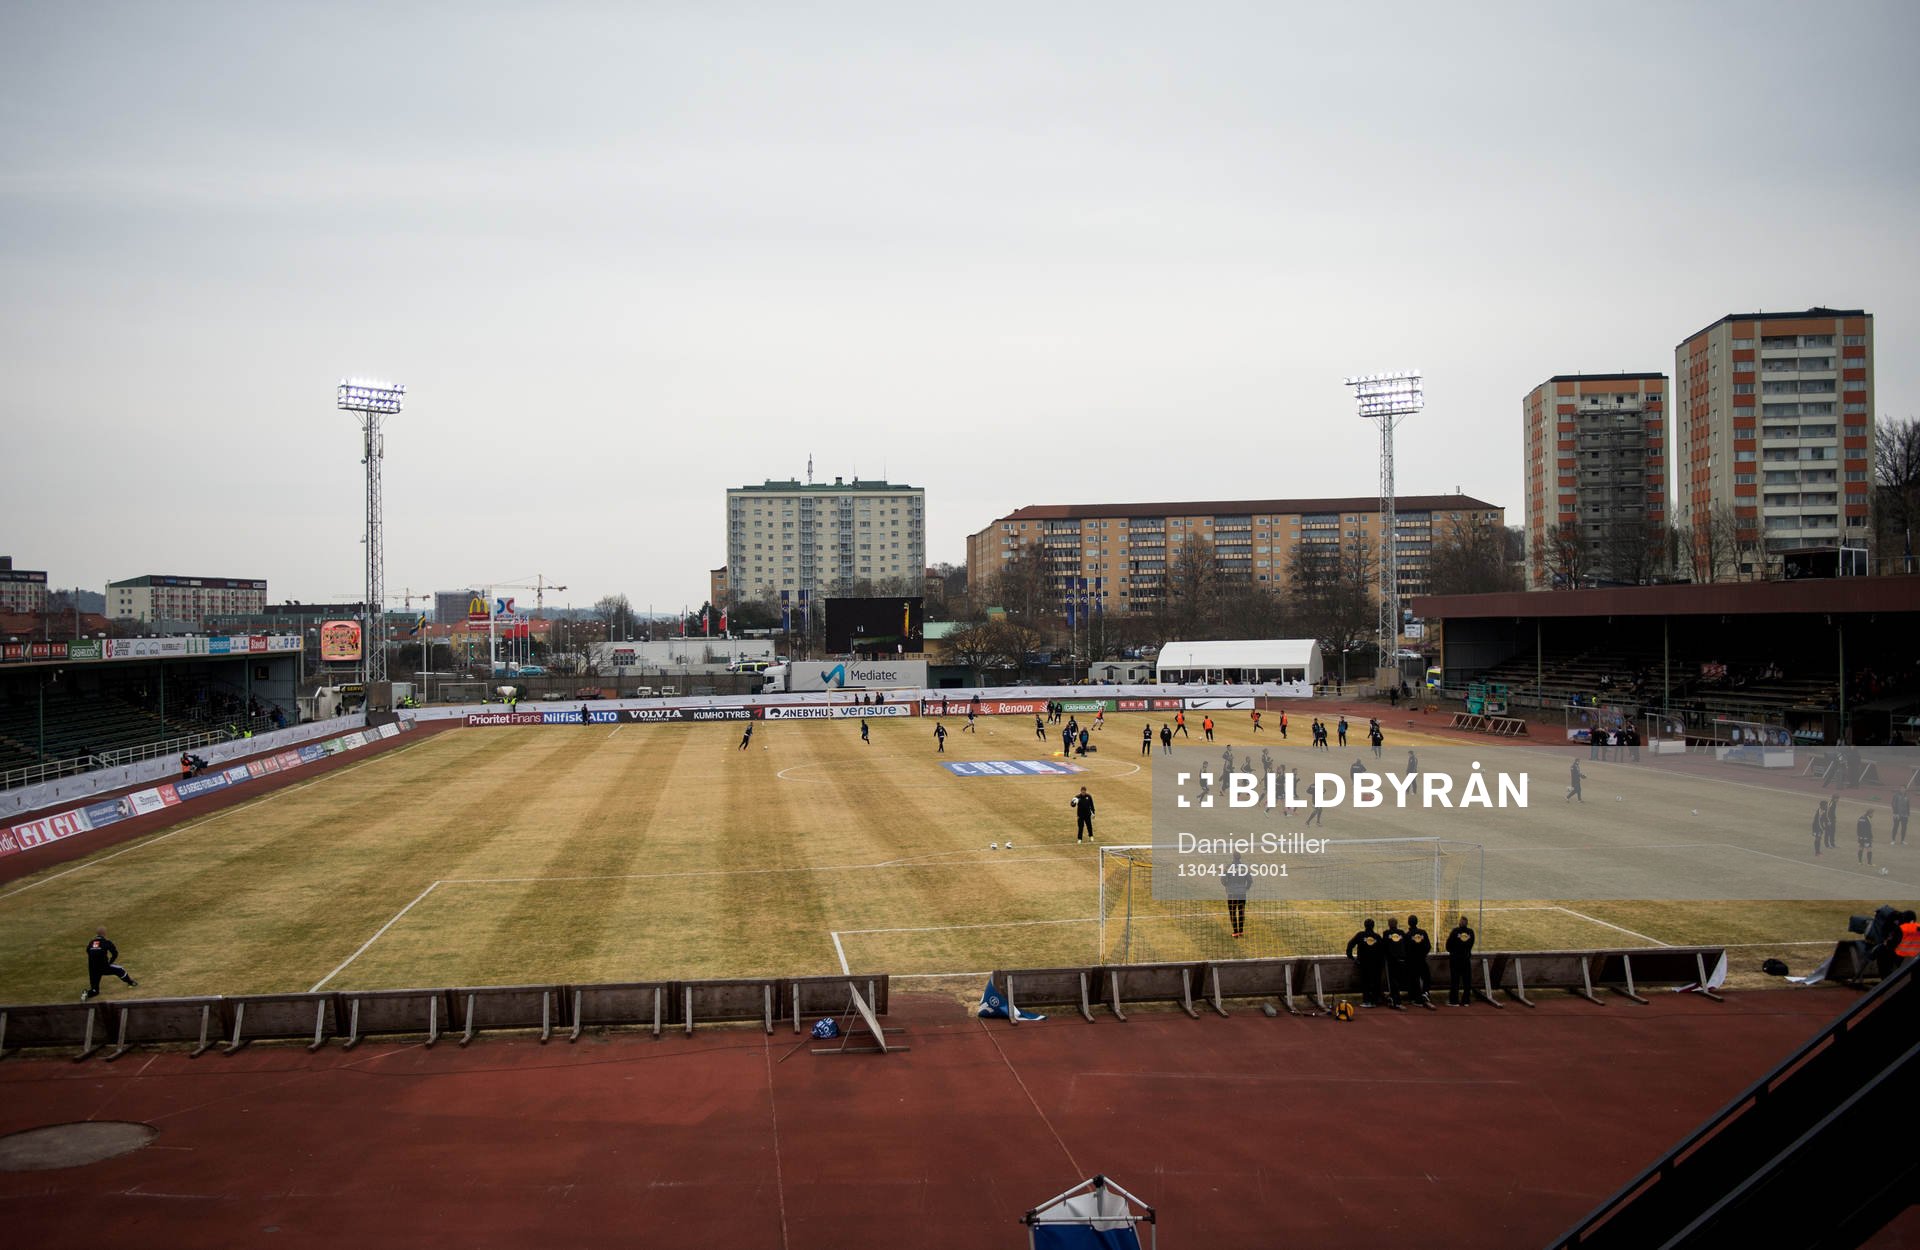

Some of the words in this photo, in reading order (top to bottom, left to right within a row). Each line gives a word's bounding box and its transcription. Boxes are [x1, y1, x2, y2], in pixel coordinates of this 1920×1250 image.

[850, 670, 897, 681] Mediatec
[781, 708, 834, 718] ANEBYHUS
[840, 706, 897, 716] verisure
[998, 702, 1033, 713] Renova
[469, 714, 511, 725] Prioritet
[511, 713, 541, 724] Finans
[543, 712, 583, 723] Nilfisk
[588, 711, 618, 722] ALTO
[629, 709, 682, 719] VOLVIA
[694, 711, 725, 720] KUMHO
[726, 710, 751, 719] TYRES
[15, 820, 51, 848] GT
[49, 811, 82, 838] GT
